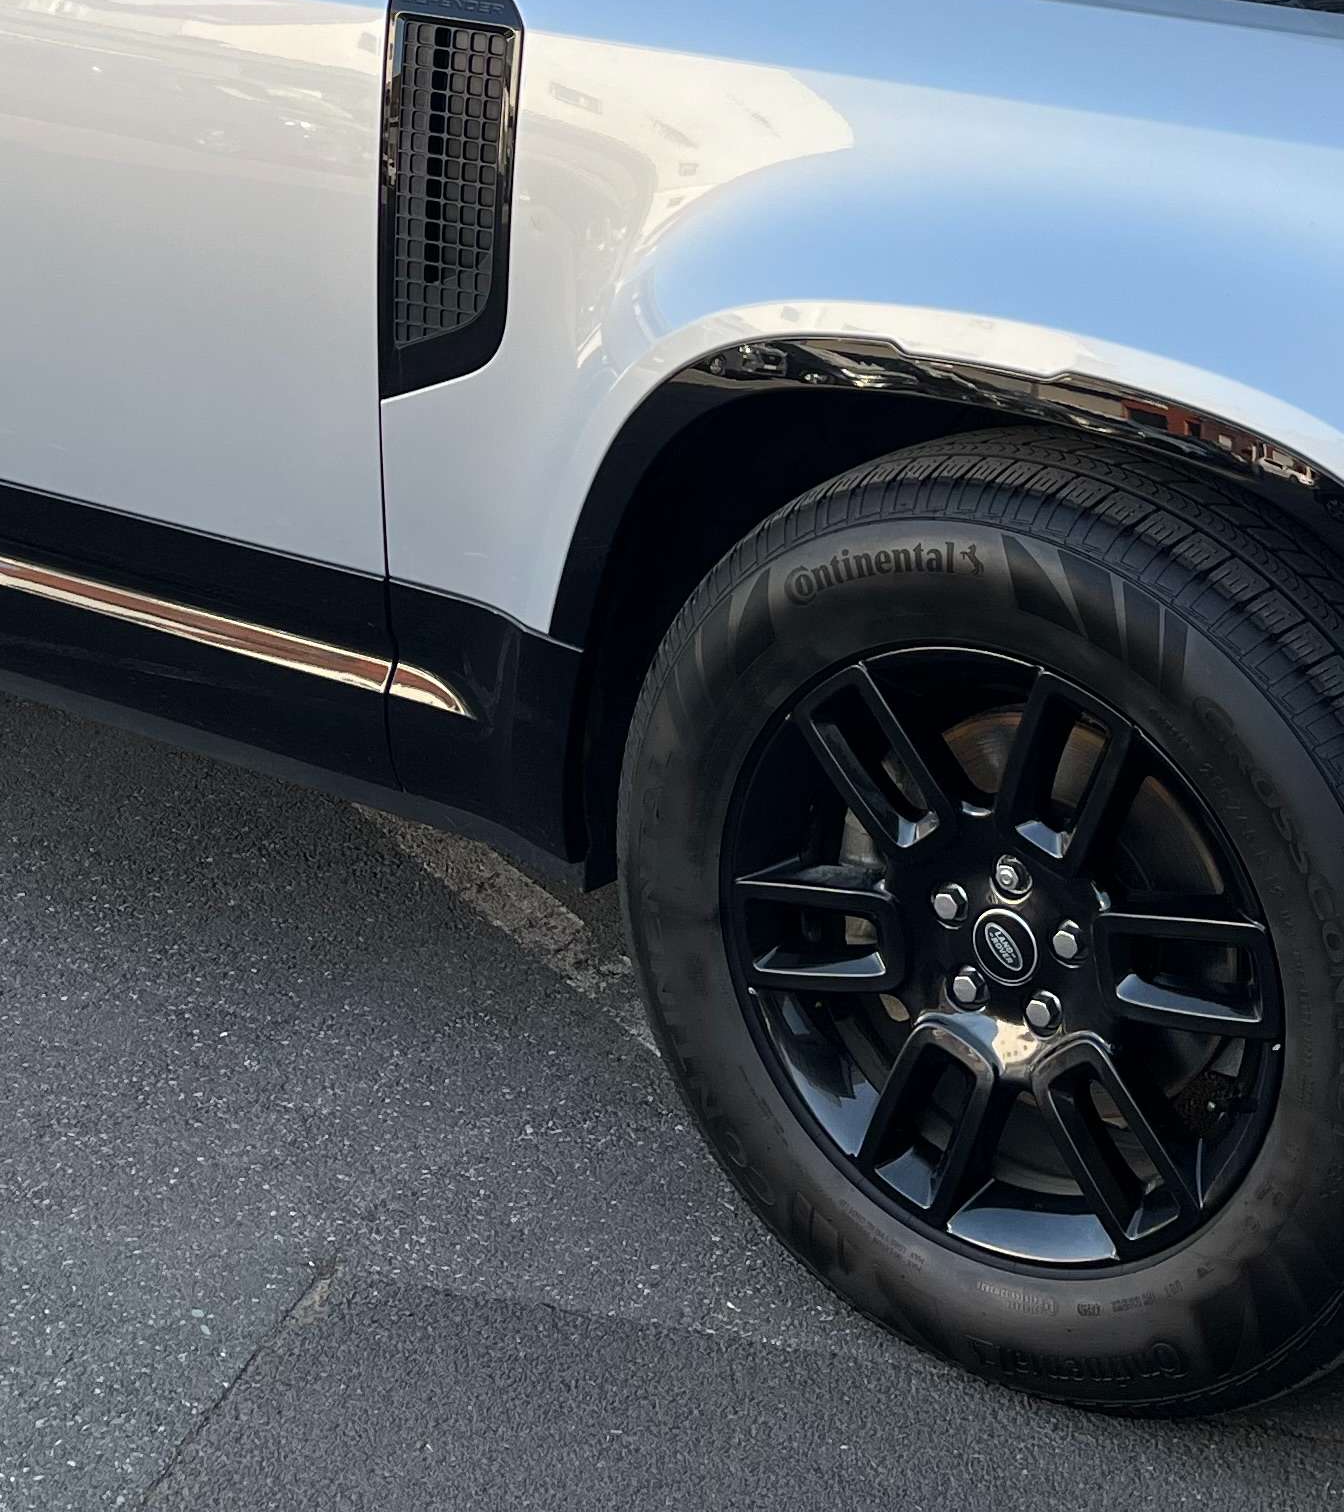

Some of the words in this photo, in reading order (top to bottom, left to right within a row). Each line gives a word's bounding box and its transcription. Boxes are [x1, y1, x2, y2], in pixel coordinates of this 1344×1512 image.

[783, 542, 956, 605] Continental
[991, 937, 1014, 964] ROVER
[995, 930, 1014, 954] LAND
